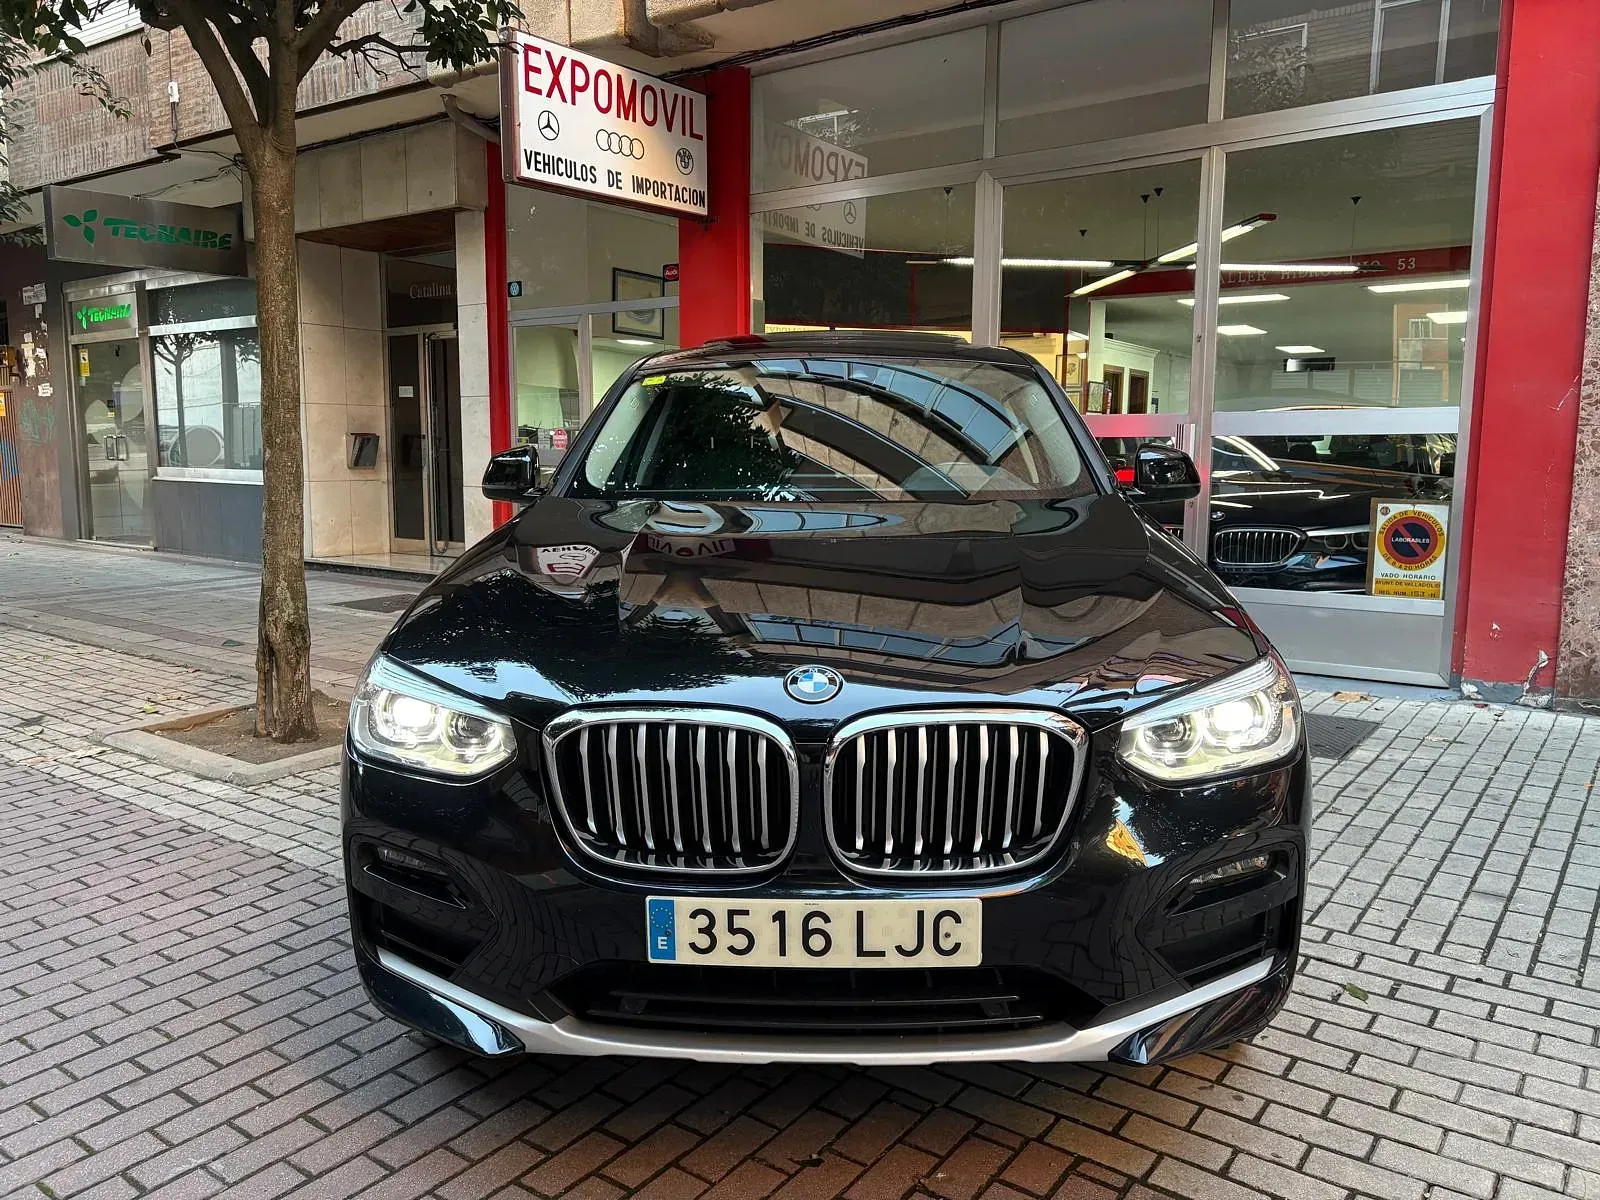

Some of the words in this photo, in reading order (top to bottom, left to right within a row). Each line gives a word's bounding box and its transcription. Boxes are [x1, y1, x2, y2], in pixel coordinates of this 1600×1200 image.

[523, 42, 704, 141] EXPOMOVIL
[524, 148, 597, 184] VEHICULOS
[607, 171, 623, 191] DE
[632, 174, 706, 209] IMPORTACION
[102, 217, 233, 249] TECNAIRE
[1396, 257, 1416, 271] 53
[1379, 514, 1398, 535] SALIDA
[1413, 510, 1444, 537] VEHICULOS
[1402, 572, 1436, 581] HORARIO
[1414, 555, 1438, 571] HORAS
[657, 936, 668, 950] E
[688, 908, 833, 958] 3516
[856, 909, 963, 958] LJC
